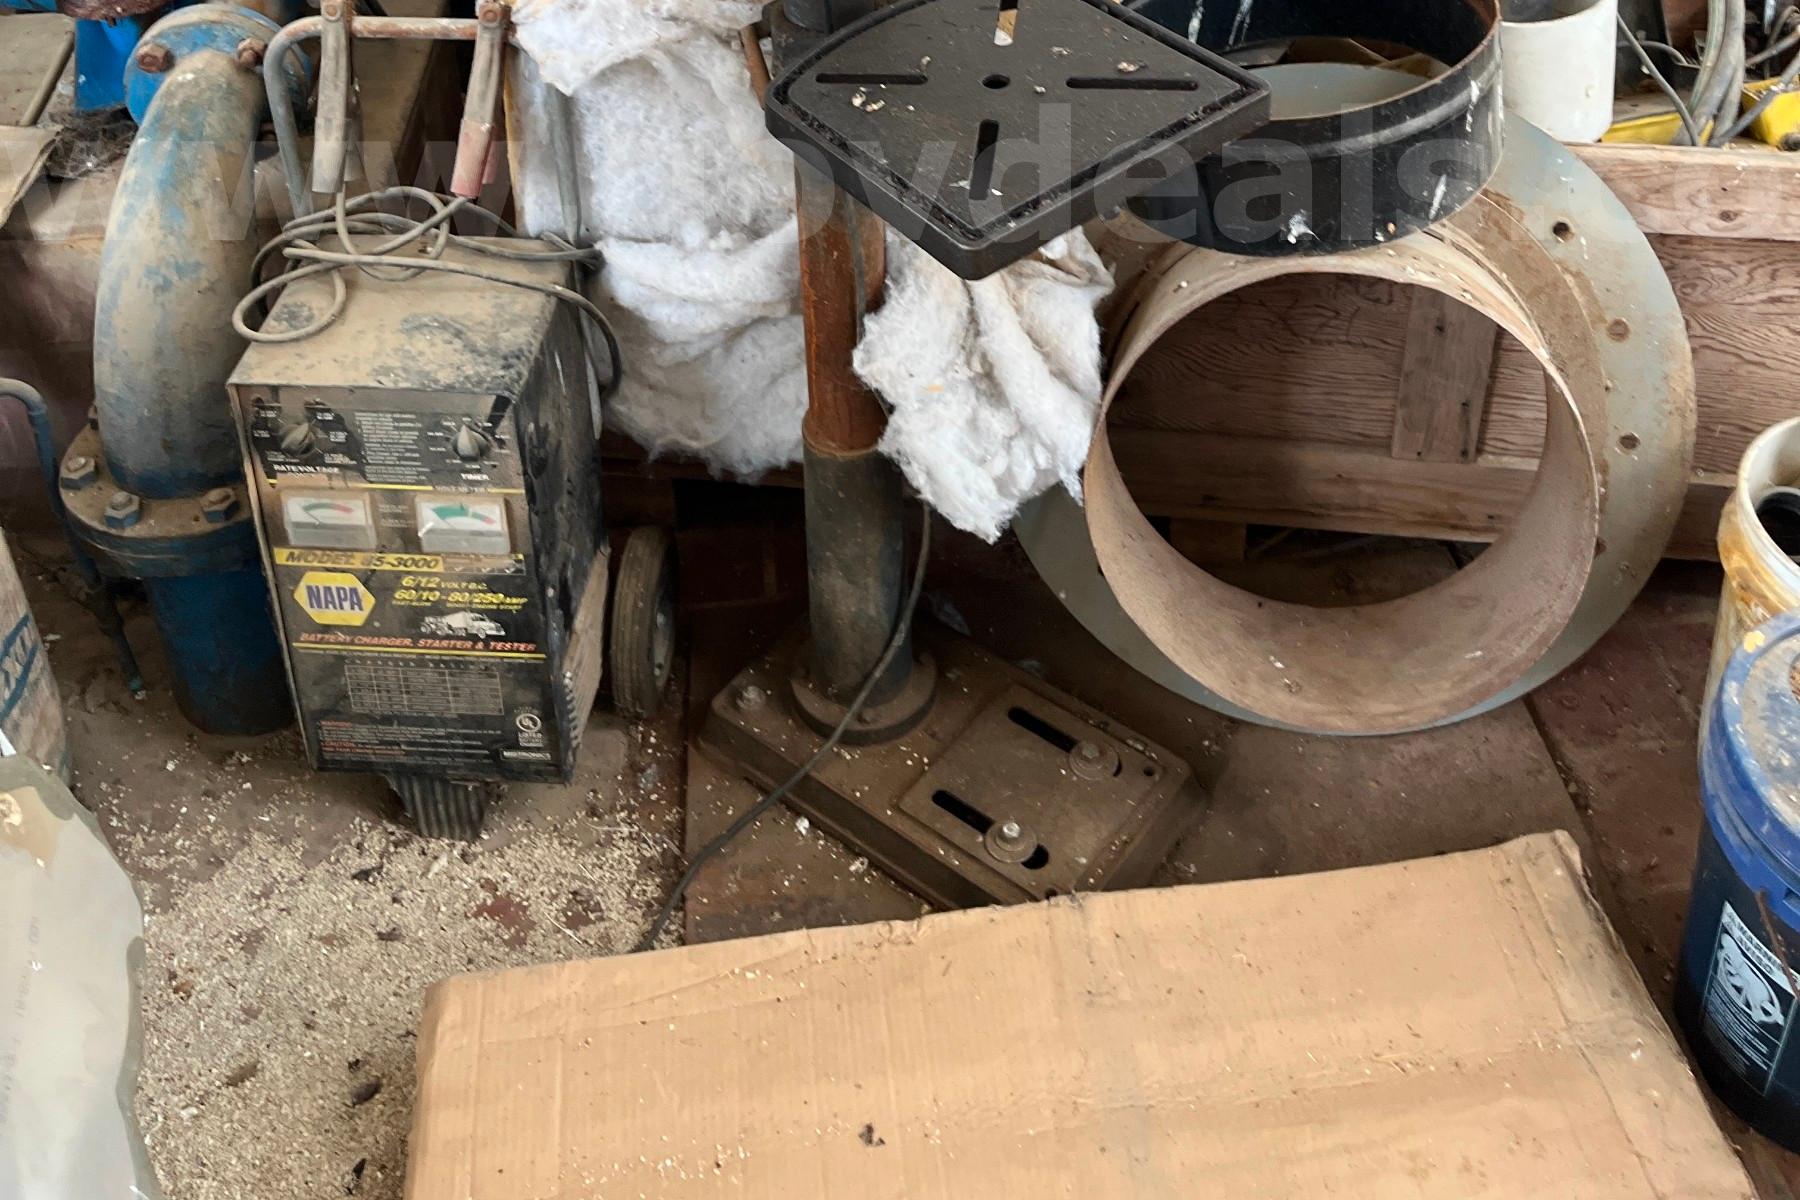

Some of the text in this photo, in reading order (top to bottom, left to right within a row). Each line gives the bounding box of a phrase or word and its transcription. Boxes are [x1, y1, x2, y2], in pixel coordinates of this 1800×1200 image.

[286, 550, 356, 566] MODEL
[402, 575, 441, 588] 6/12
[305, 584, 365, 612] NAPA
[299, 632, 352, 644] BATTERY
[416, 638, 474, 650] STARTER
[489, 641, 537, 652] TESTER
